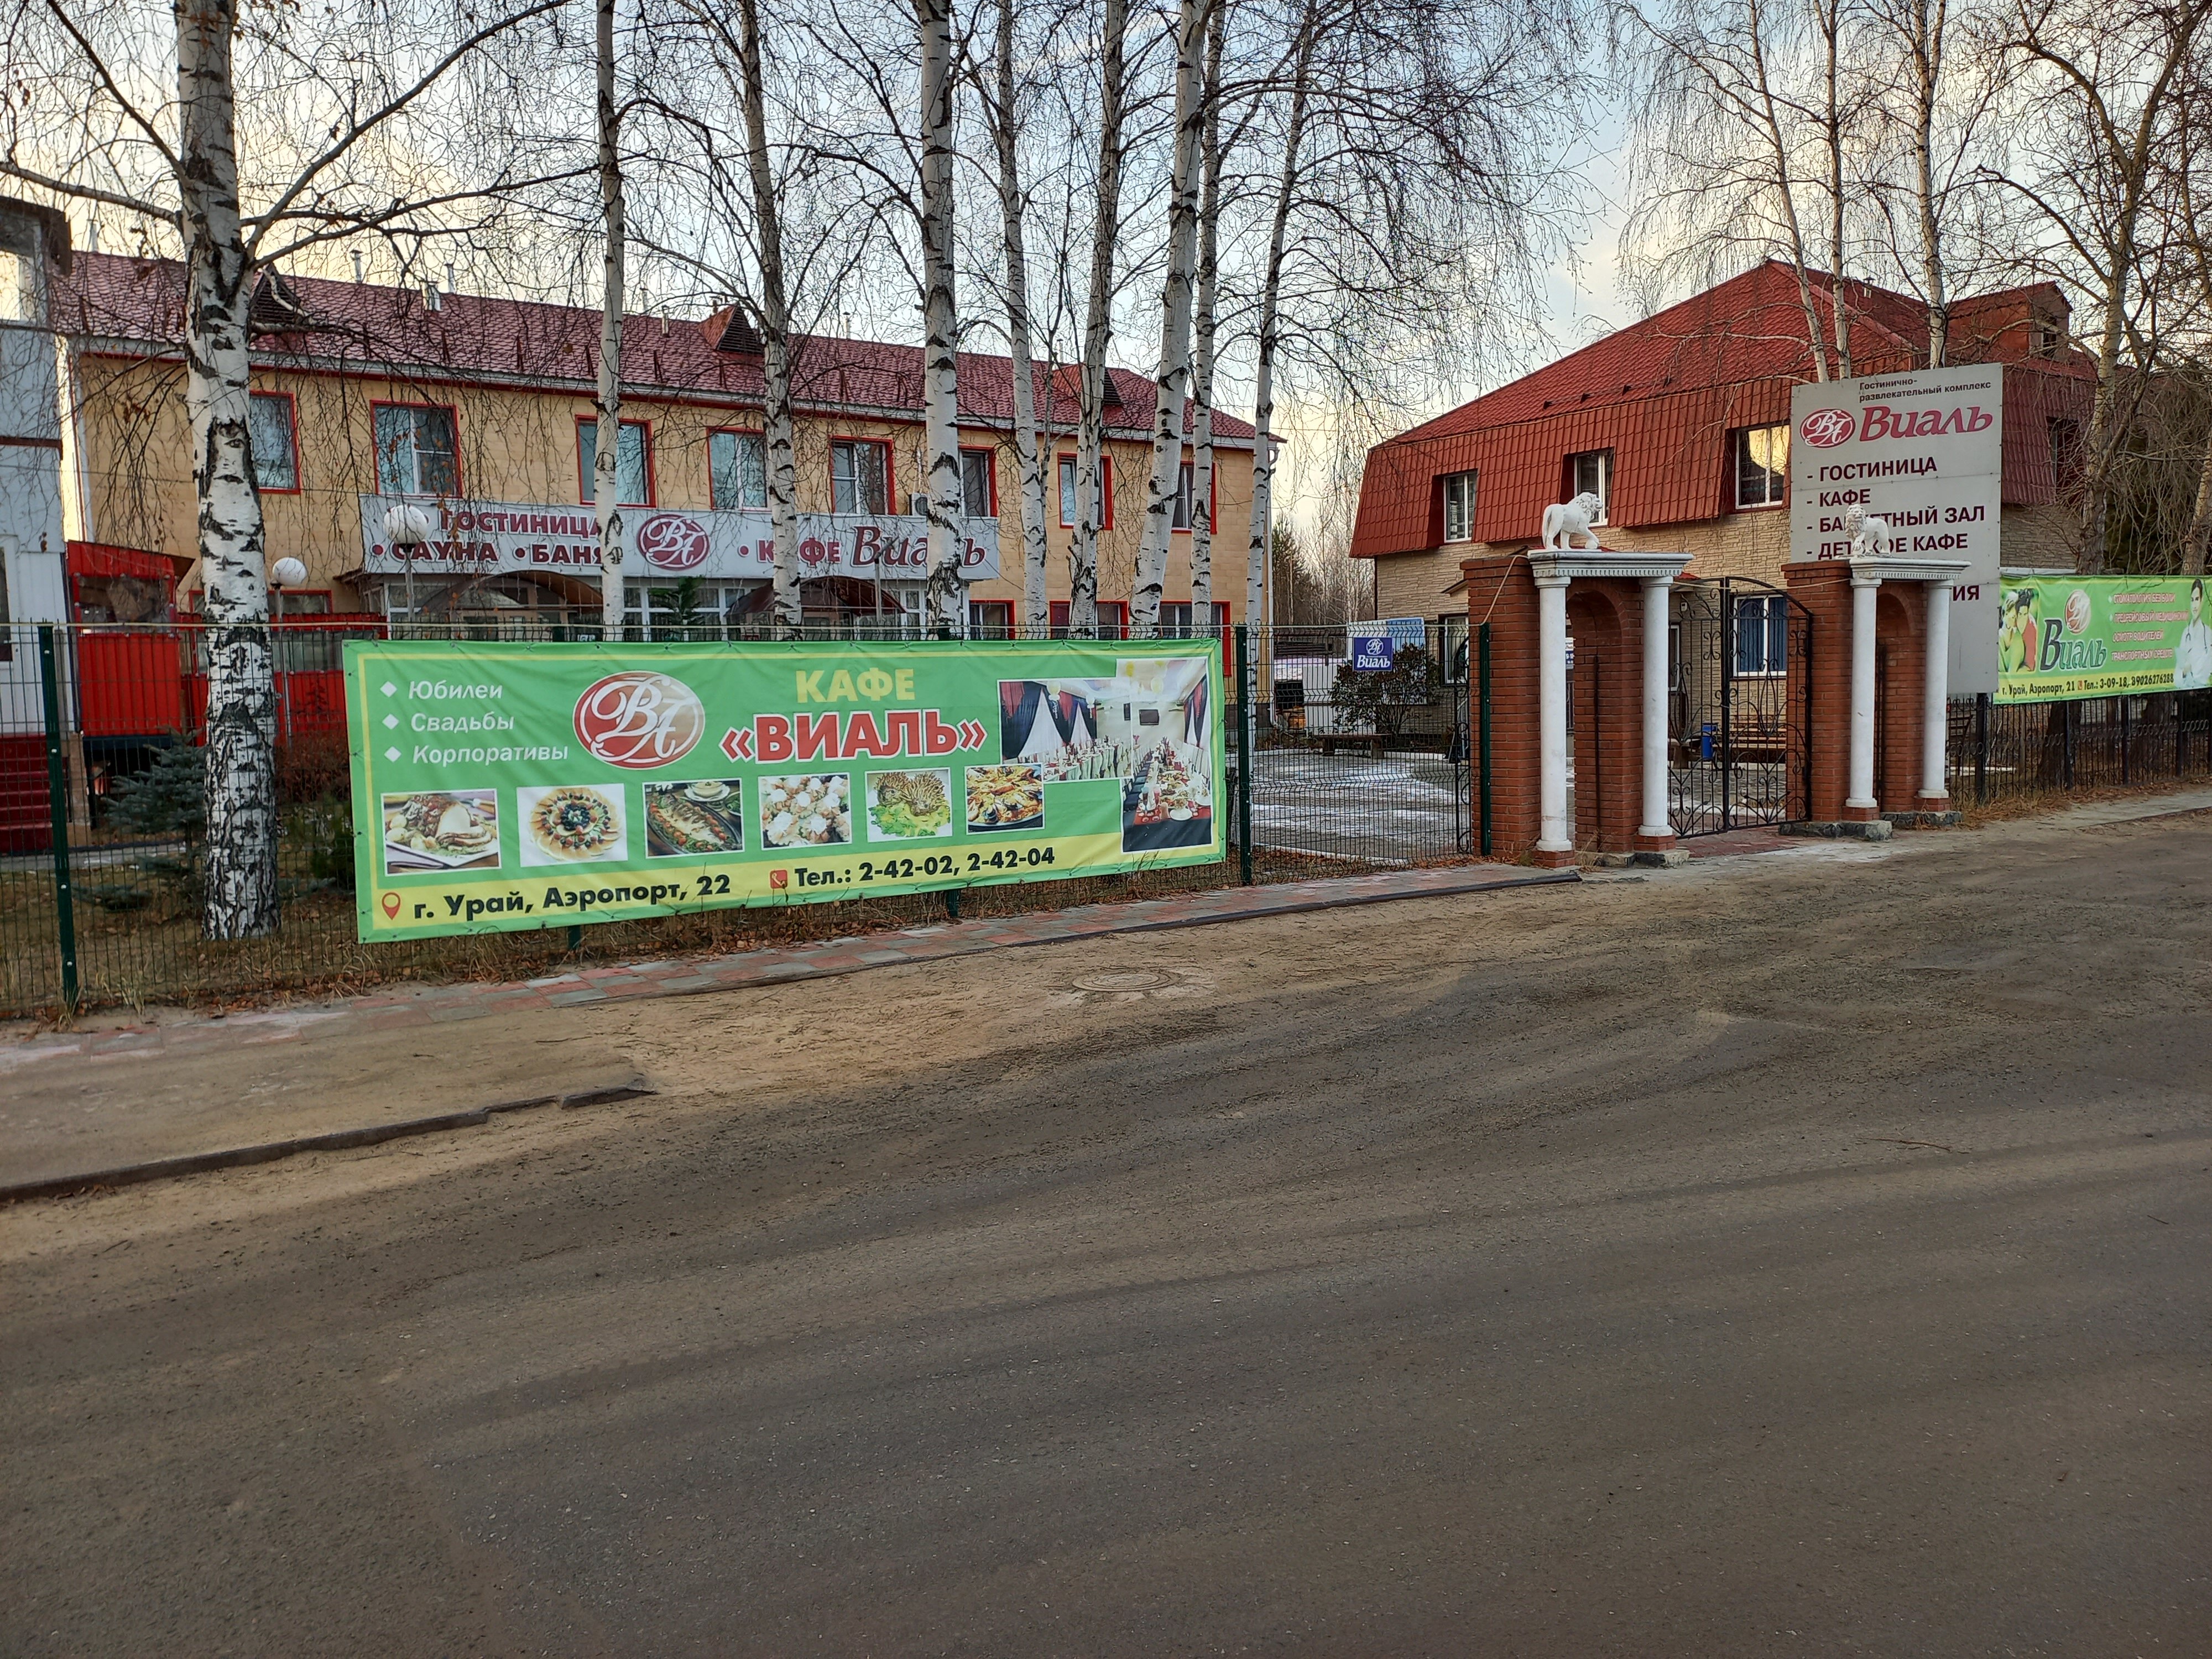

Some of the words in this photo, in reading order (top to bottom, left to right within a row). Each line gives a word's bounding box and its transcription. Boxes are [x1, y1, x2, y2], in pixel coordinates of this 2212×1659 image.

[1859, 385, 1942, 403] развлекательный
[1944, 381, 1991, 393] комплекс
[1860, 378, 1917, 390] Гостинично-
[1859, 405, 1993, 442] Виаль
[1820, 457, 1937, 482] ГОСТИНИЦА
[1819, 488, 1871, 507] КАФЕ
[1944, 505, 1985, 523] ЗАЛ
[758, 538, 841, 567] КФЕ
[852, 525, 987, 567] Виаь
[1913, 533, 1968, 551] КАФЕ
[2040, 619, 2106, 671] Виаль
[1357, 655, 1390, 668] Виаль
[796, 669, 916, 703] КАФЕ
[2008, 684, 2027, 698] Урай,
[2030, 684, 2064, 697] Аэропорт,
[2066, 681, 2074, 691] 21
[2084, 680, 2098, 690] Тел.:
[410, 713, 514, 733] Свадьбы
[721, 709, 988, 764] «ВИАЛЬ»
[413, 744, 568, 766] Корпоративы
[795, 867, 851, 886] Тел.:
[859, 856, 959, 881] 2-42-02,
[968, 847, 1055, 868] 2-42-04
[414, 901, 435, 919] г.
[445, 895, 533, 921] Урай,
[543, 880, 687, 909] Аэропорт,
[697, 874, 731, 895] 22
